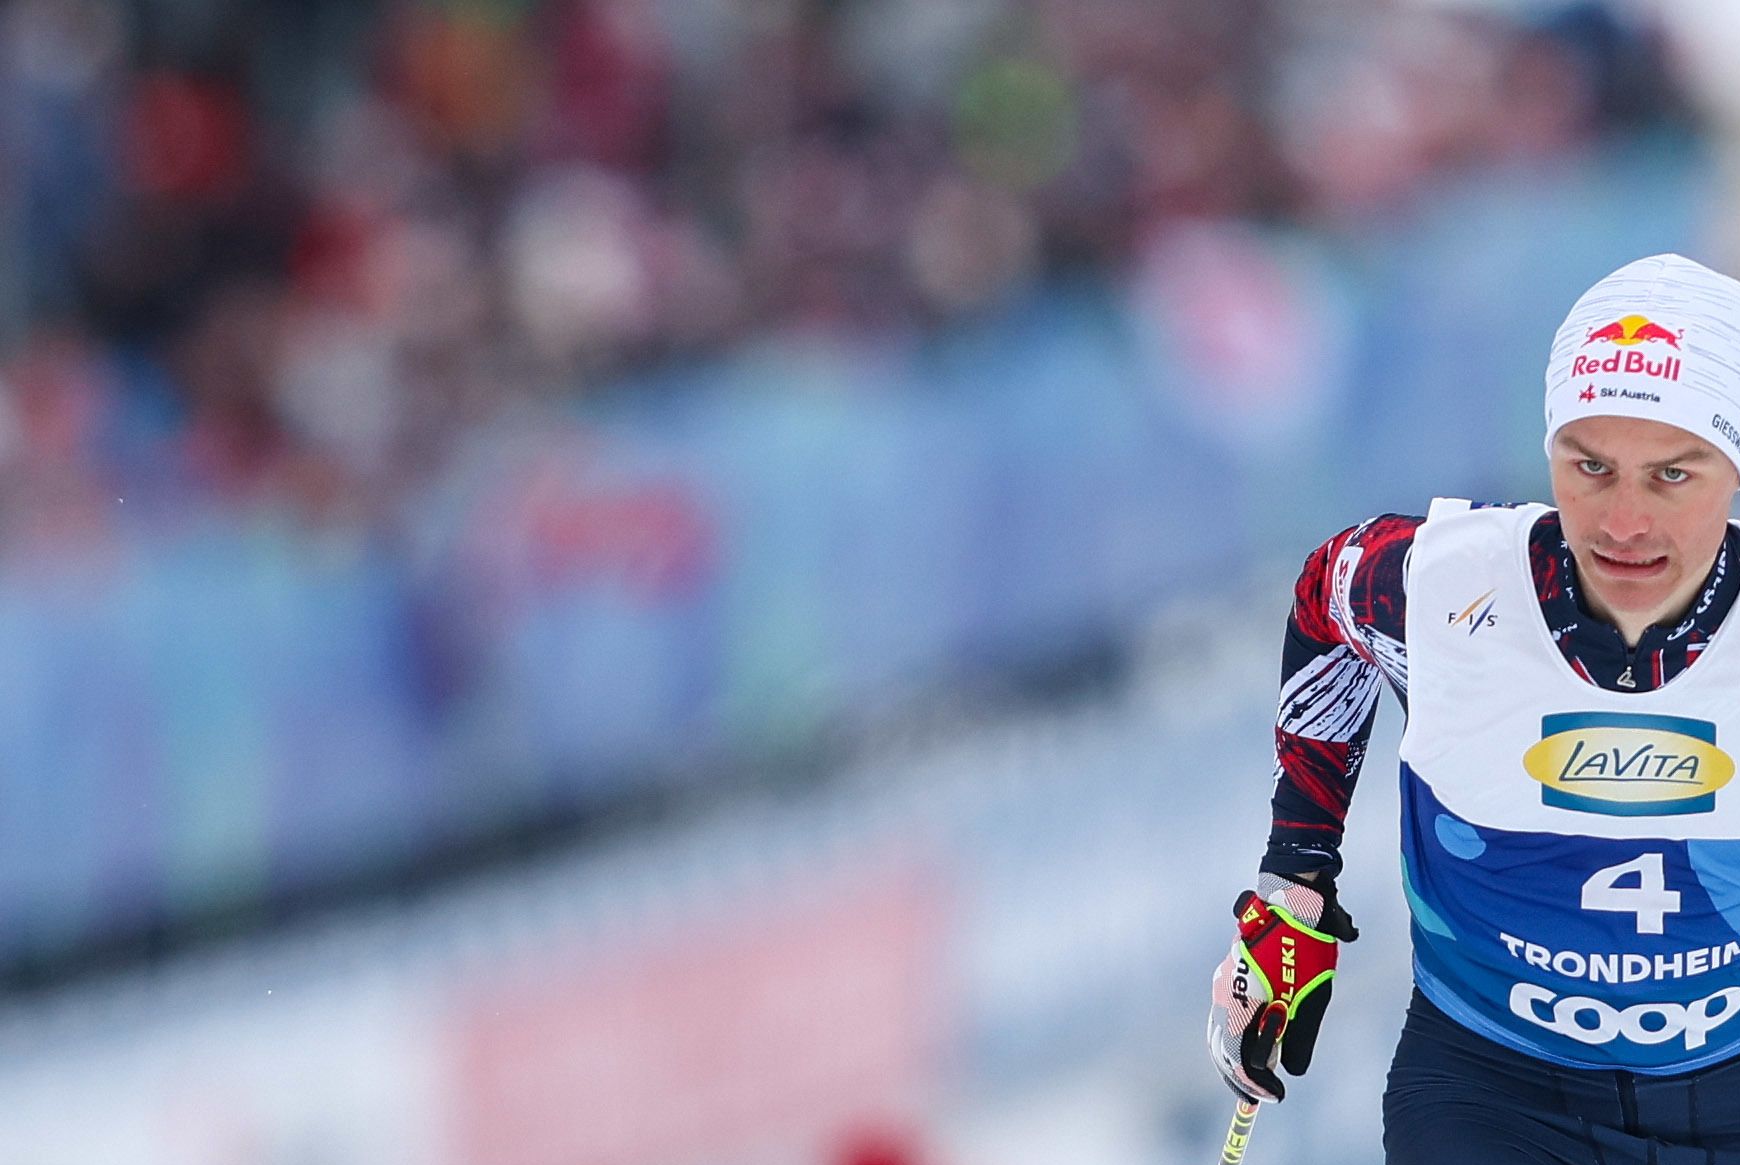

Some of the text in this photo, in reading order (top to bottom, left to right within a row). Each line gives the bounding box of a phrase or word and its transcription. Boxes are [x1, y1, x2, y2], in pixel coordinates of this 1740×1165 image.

[1571, 350, 1681, 382] Red Bull
[1600, 387, 1661, 402] Ski Austria
[1580, 853, 1681, 935] 4
[1281, 936, 1295, 1002] LEKI
